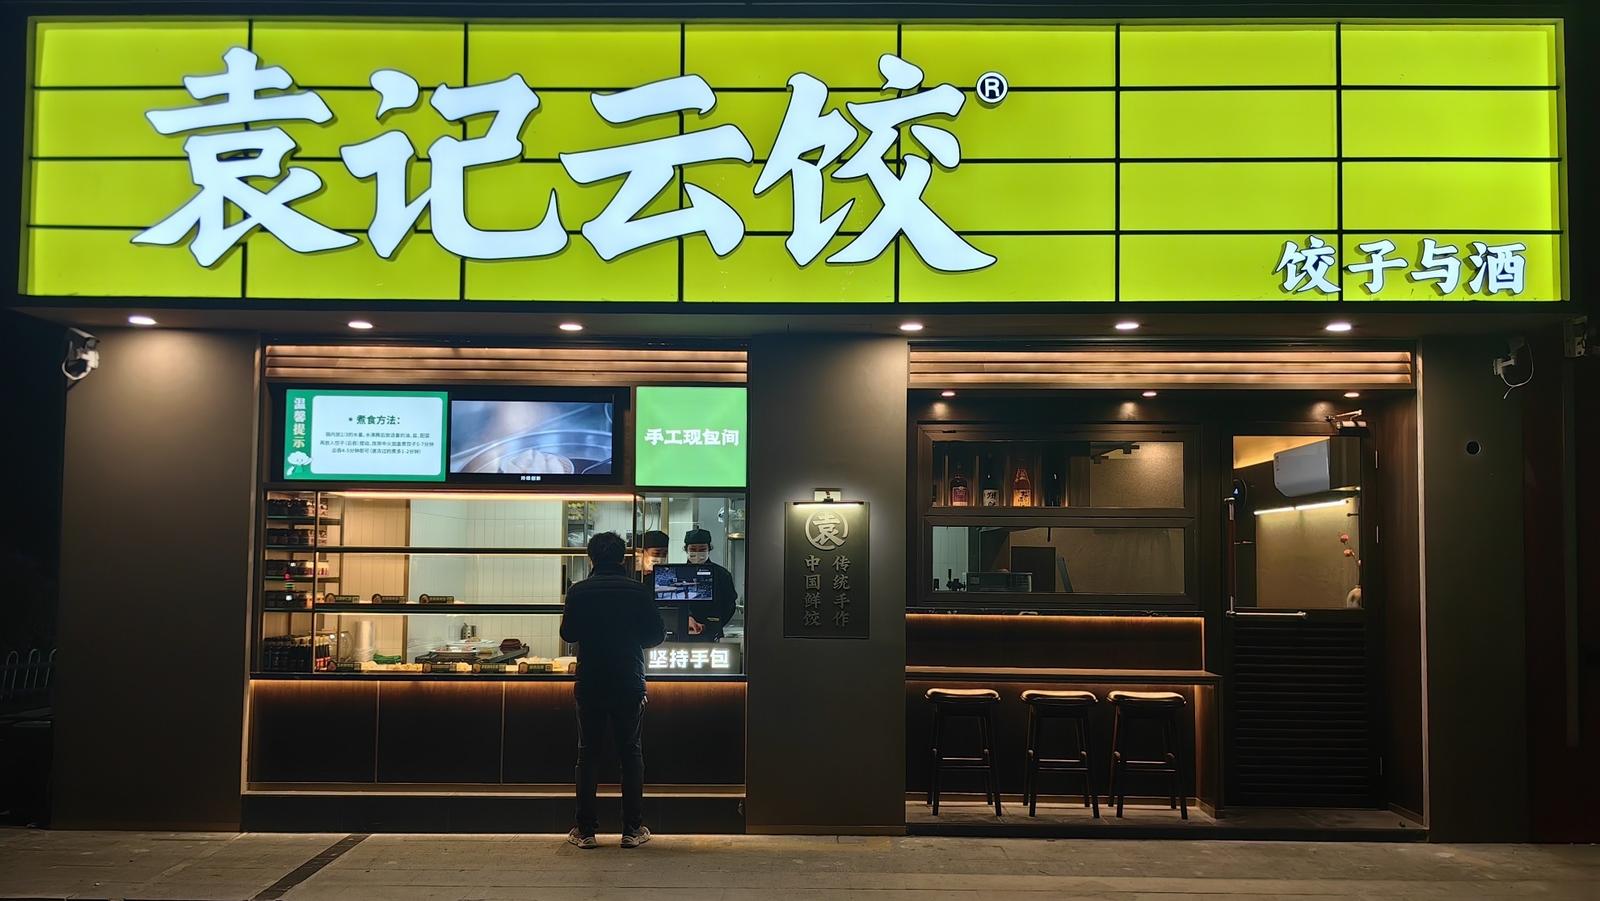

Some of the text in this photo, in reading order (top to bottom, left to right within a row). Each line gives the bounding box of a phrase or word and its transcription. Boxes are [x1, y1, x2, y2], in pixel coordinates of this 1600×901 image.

[131, 46, 998, 271] 袁记云饺
[1274, 236, 1526, 296] 饺子与酒
[293, 397, 306, 449] 温馨提示
[644, 428, 740, 447] 手工现包间
[812, 511, 845, 547] 袁
[804, 555, 821, 626] 中国鲜饺
[832, 555, 850, 627] 传统手作
[649, 649, 730, 668] 坚持手包
